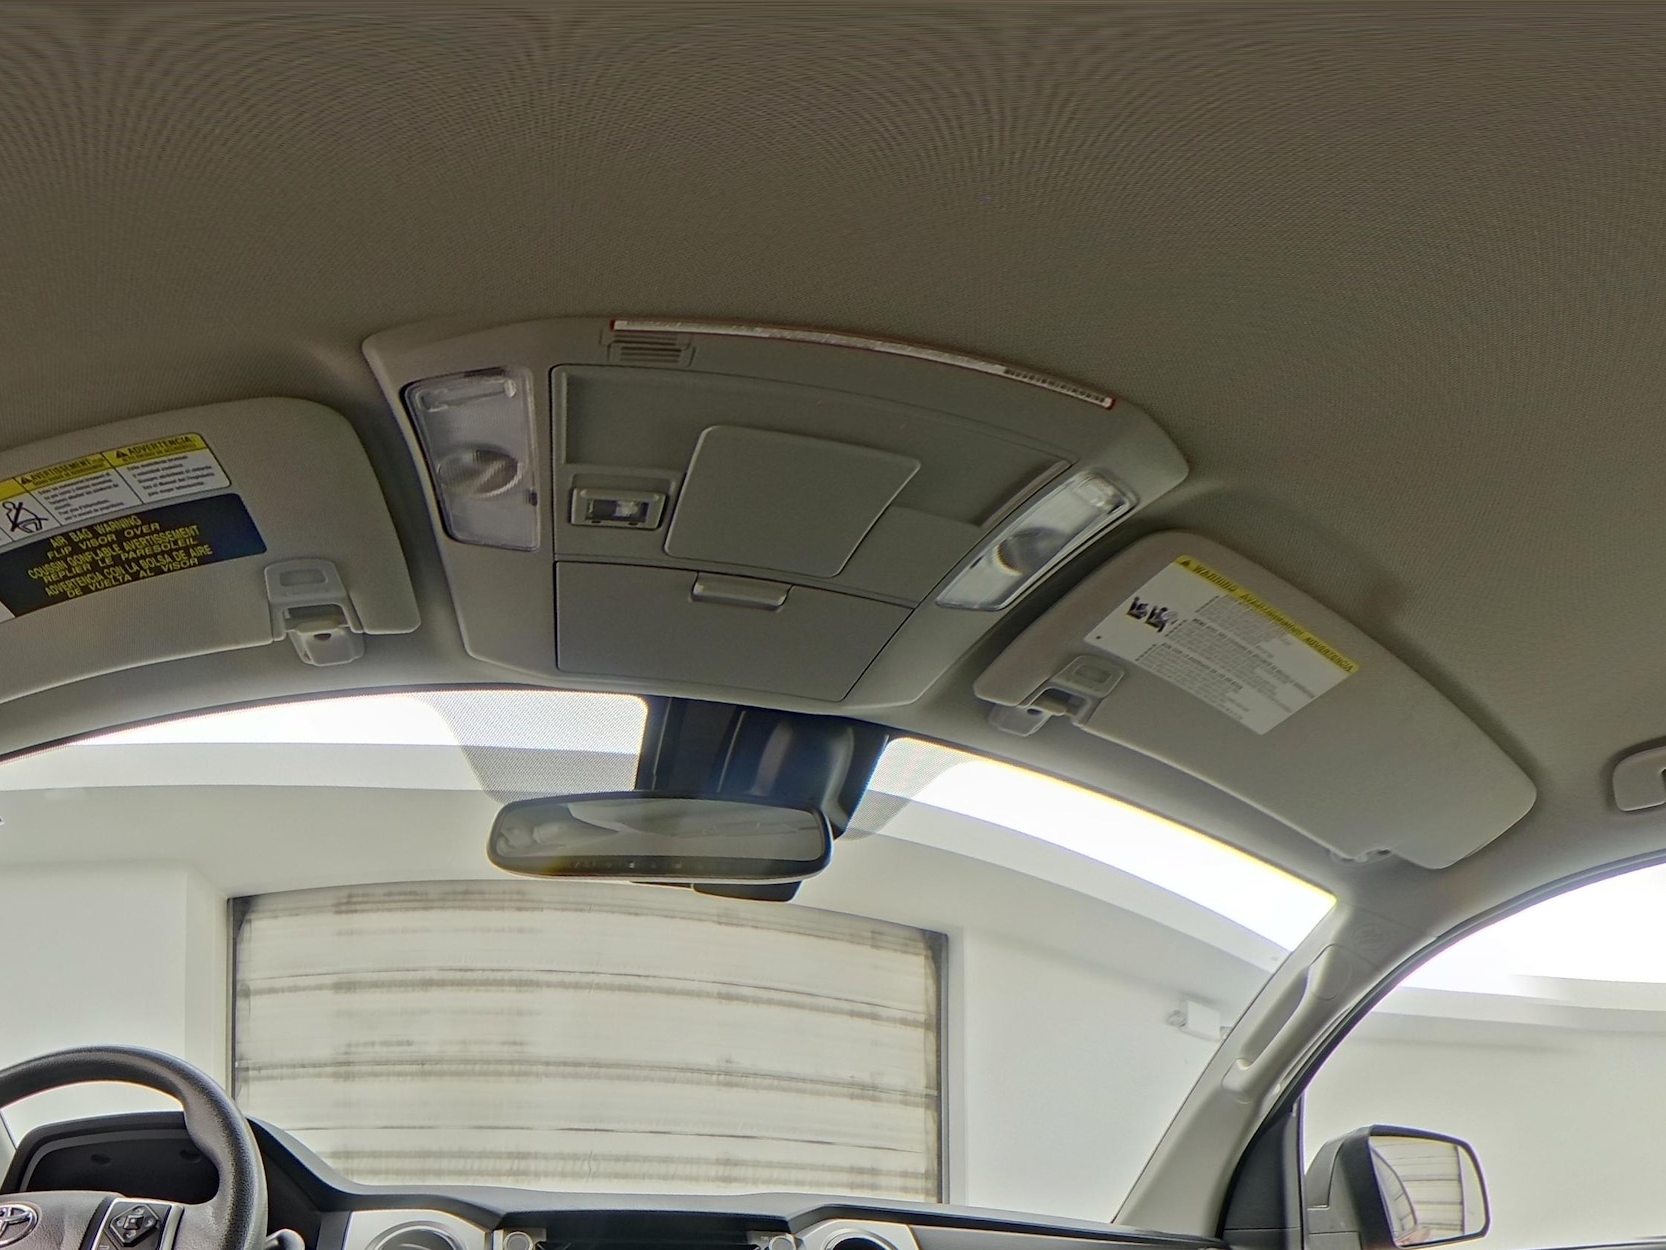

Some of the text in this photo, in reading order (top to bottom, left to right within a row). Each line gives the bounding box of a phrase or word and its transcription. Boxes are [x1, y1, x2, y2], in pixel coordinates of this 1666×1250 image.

[27, 524, 200, 580] COUSSIN GONFLABLE AVERTISSEMENT
[46, 522, 161, 560] FLIP VISOR OVER
[50, 515, 142, 548] AIR BAG WARNING
[42, 538, 198, 584] REPLIER LE PARESOLEIL
[44, 544, 214, 597] ADVERTENCIA CON LA BOLSA DE AIRE
[66, 557, 199, 599] DE VUELTA AL VISOR
